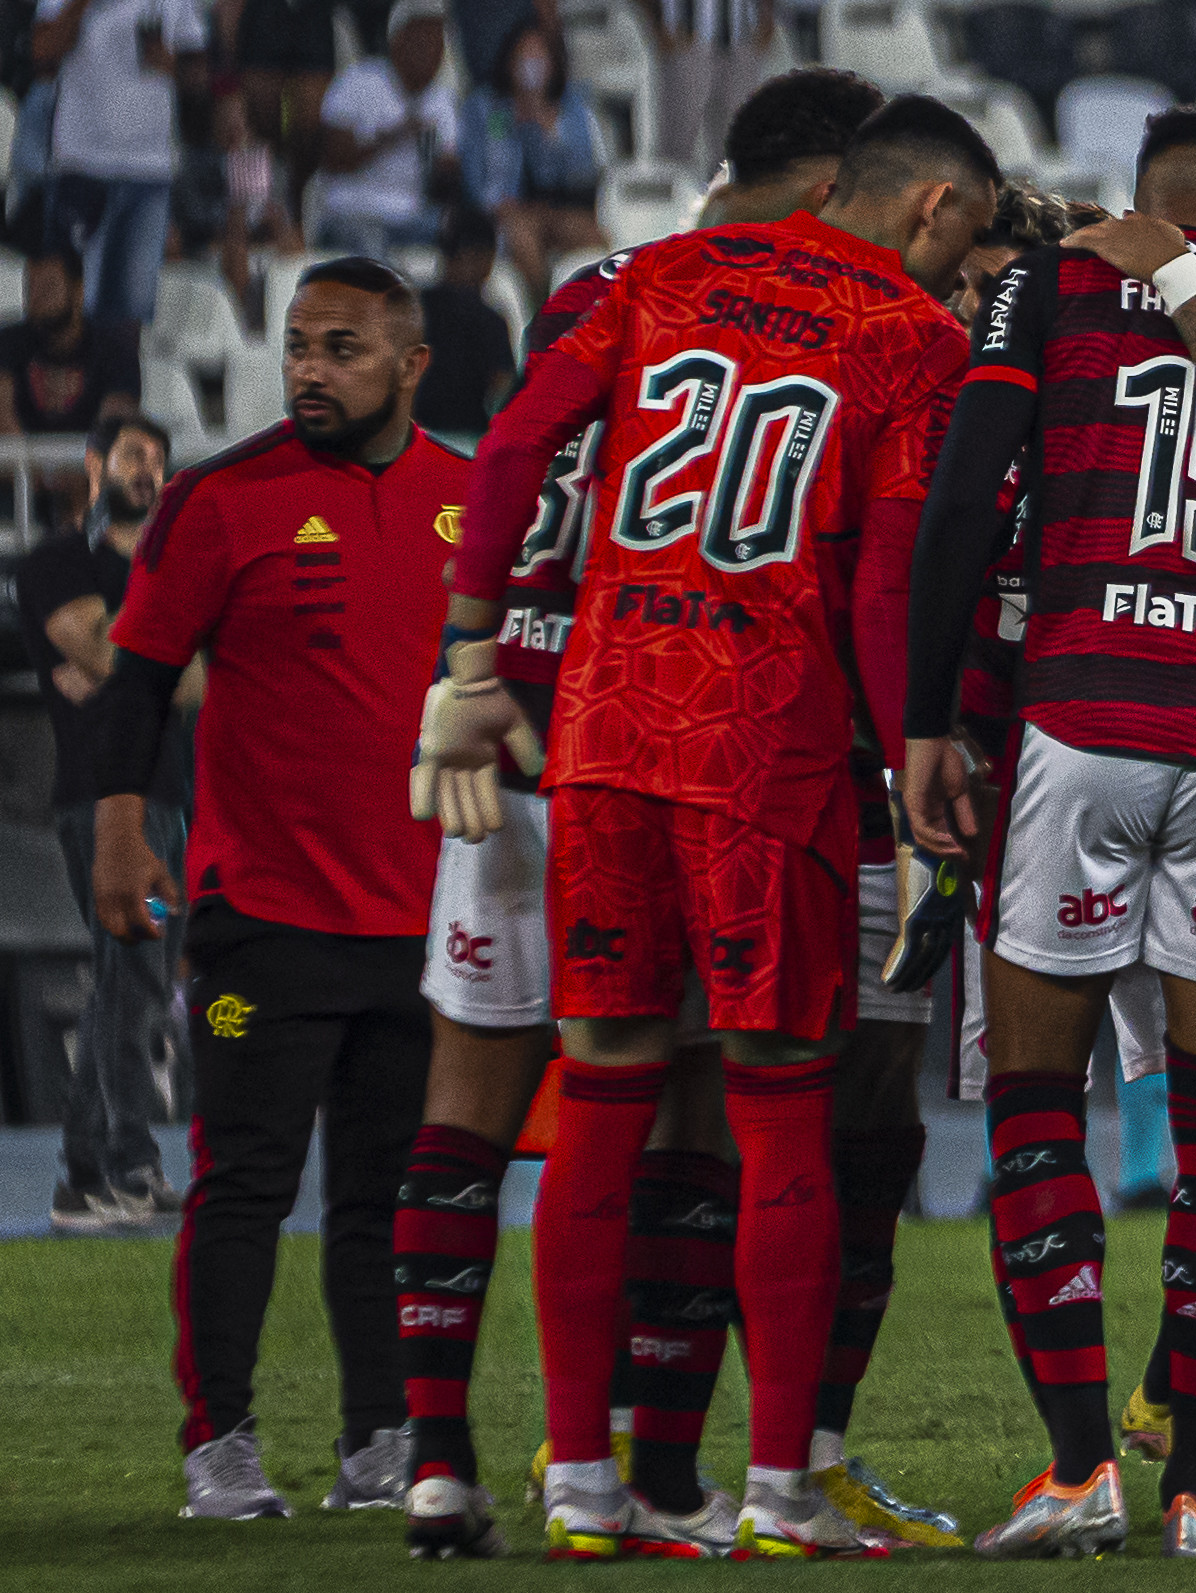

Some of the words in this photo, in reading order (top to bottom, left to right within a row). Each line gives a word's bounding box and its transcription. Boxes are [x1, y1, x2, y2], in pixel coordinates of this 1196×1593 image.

[700, 289, 834, 349] SANTOS
[982, 268, 1027, 351] HAVAN
[698, 383, 718, 412] TIM
[1163, 387, 1180, 416] TIM
[795, 411, 817, 440] TIM
[609, 348, 841, 573] 20
[496, 606, 576, 654] FlaT
[1057, 883, 1128, 929] abc
